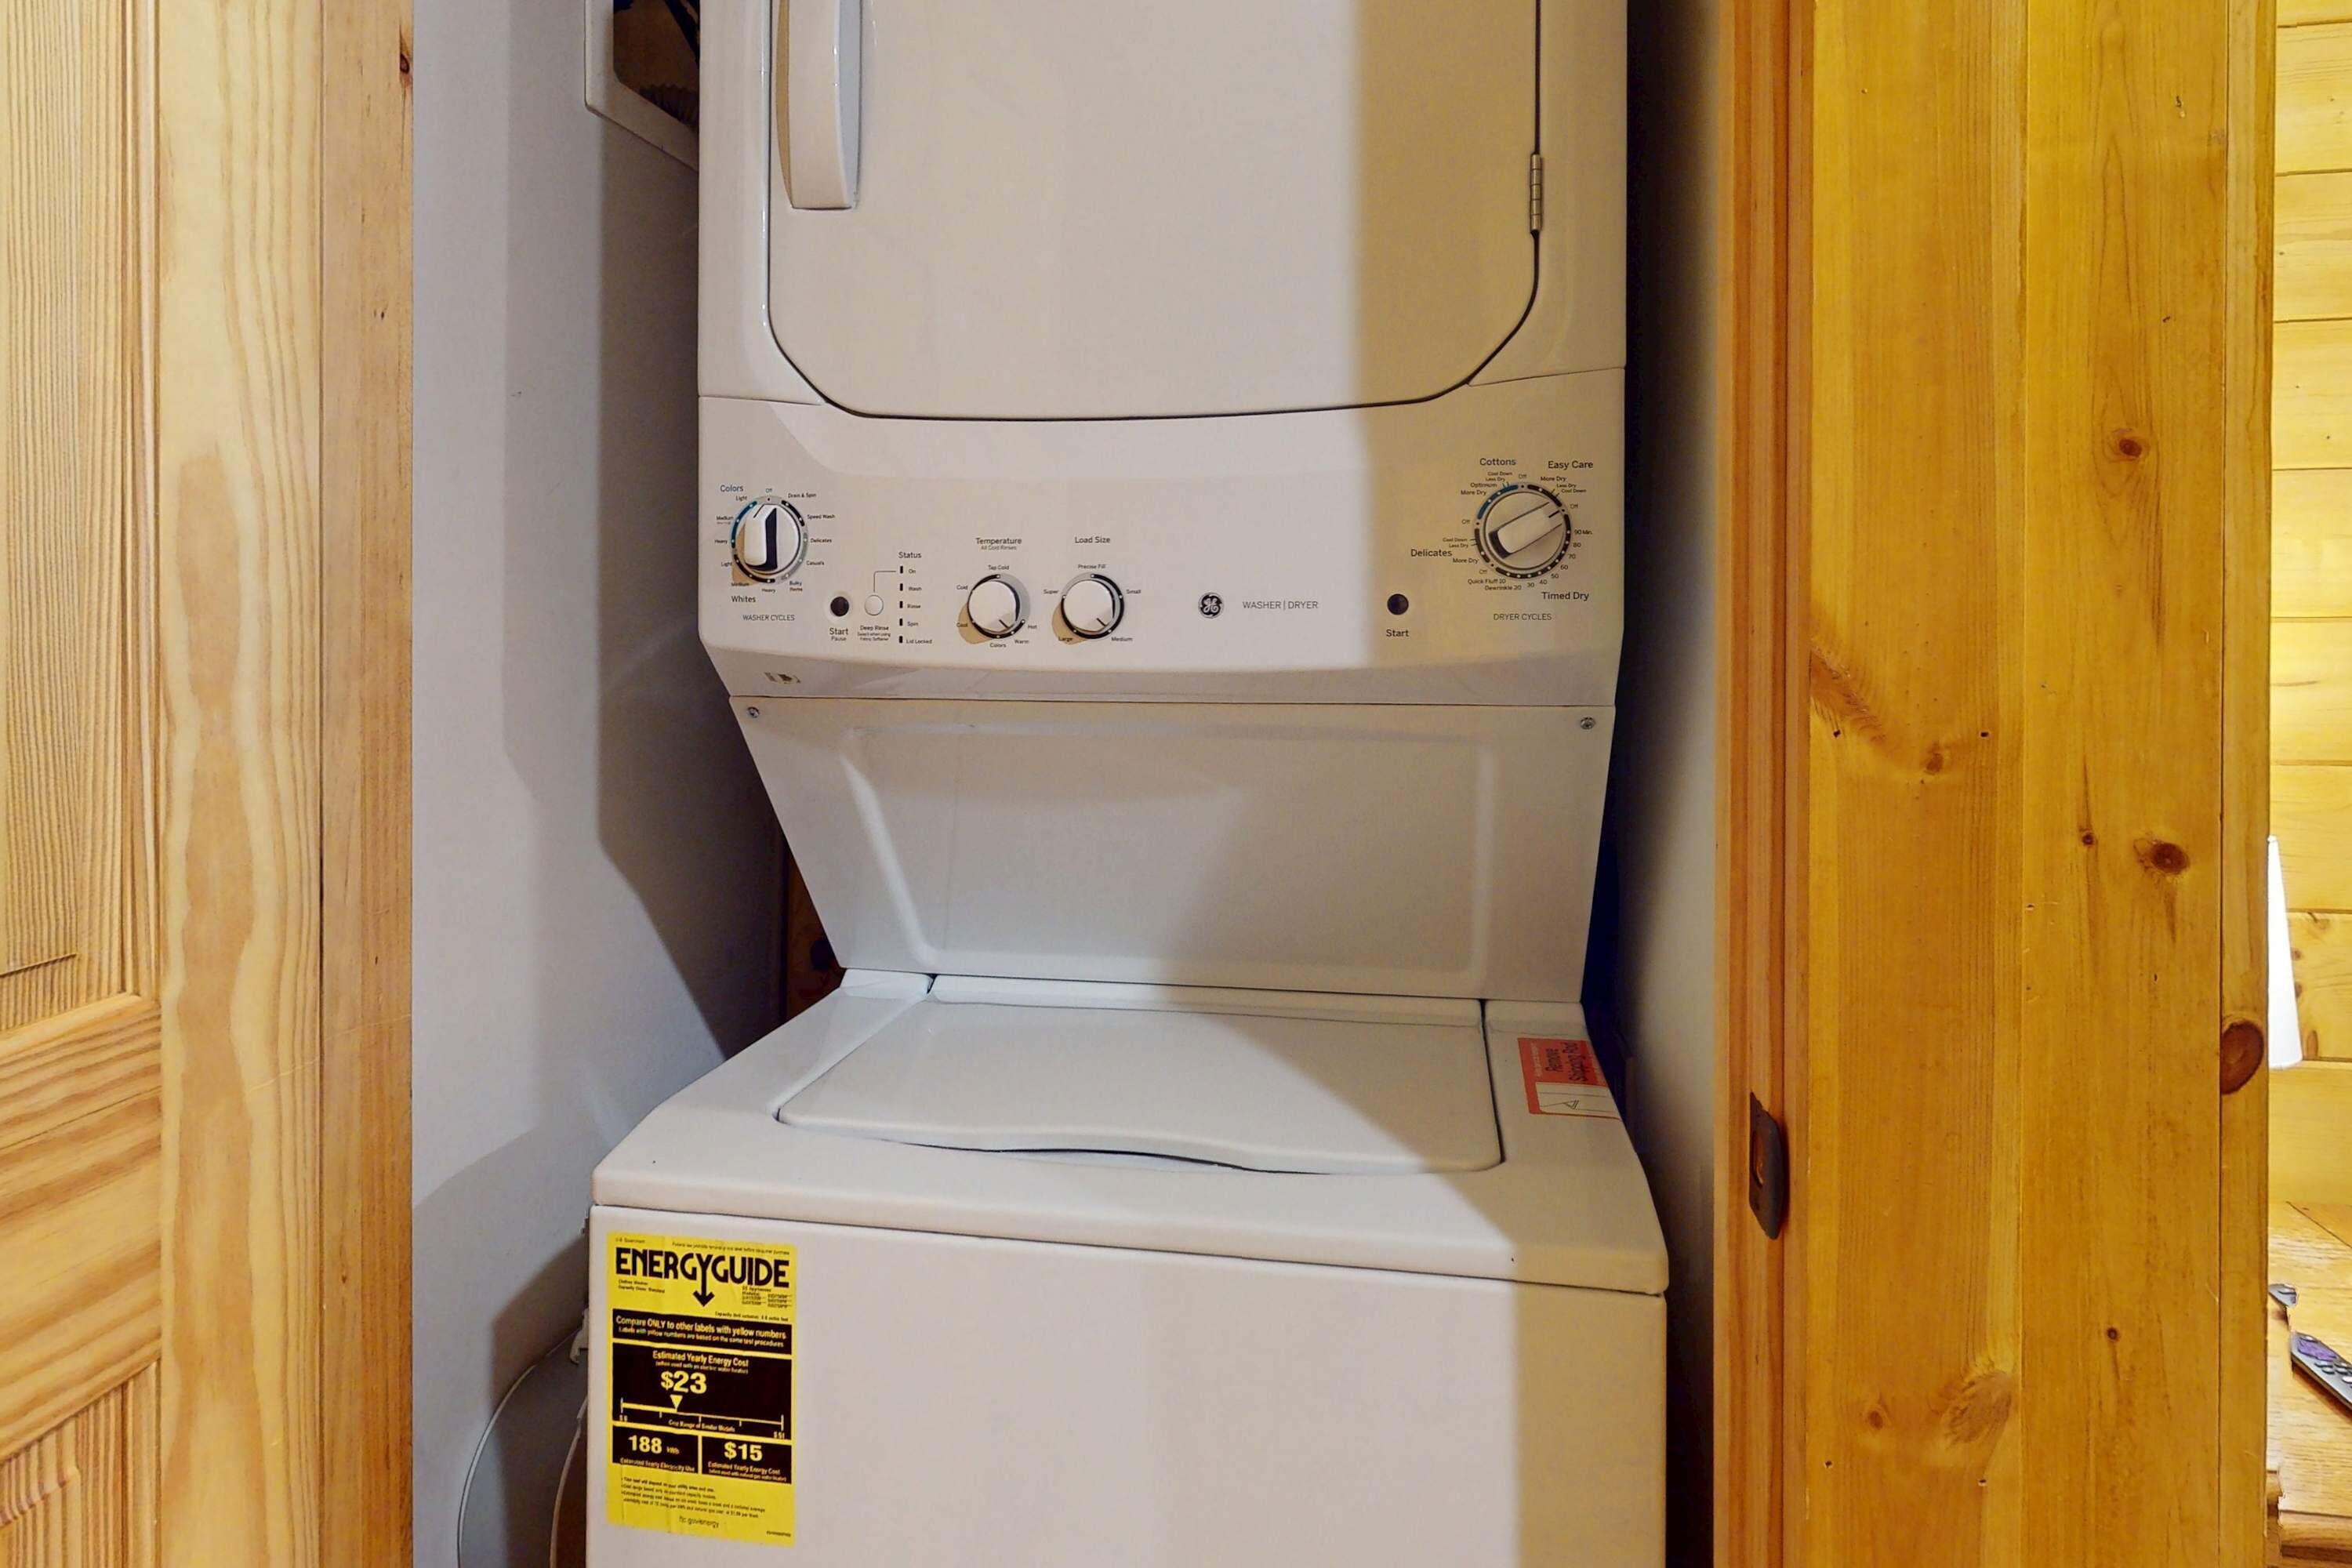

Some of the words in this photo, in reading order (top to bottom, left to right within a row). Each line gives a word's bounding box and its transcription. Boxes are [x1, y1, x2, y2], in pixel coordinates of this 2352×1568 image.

[1548, 461, 1570, 470] Easy
[975, 537, 1022, 546] Temperature
[1410, 549, 1453, 557] Delicates
[1541, 591, 1571, 601] Timed
[1572, 591, 1590, 602] Dry
[1242, 601, 1281, 609] WASHER
[1287, 601, 1319, 609] DRYER
[1385, 629, 1410, 637] Start
[615, 1247, 789, 1288] ENERGYGUIDE
[615, 1316, 646, 1327] Compare
[647, 1318, 666, 1329] ONLY
[666, 1320, 675, 1329] to
[676, 1322, 694, 1330] other
[694, 1322, 715, 1334] labels
[716, 1325, 731, 1334] with
[731, 1327, 754, 1338] yellow
[755, 1329, 787, 1340] numbers
[652, 1350, 686, 1361] Estimated
[687, 1352, 707, 1365] Yearly
[708, 1355, 732, 1367] Energy
[732, 1357, 749, 1367] Cost
[661, 1370, 707, 1395] $23
[628, 1435, 662, 1454] 188
[724, 1441, 764, 1462] $15
[708, 1461, 733, 1470] Estimated
[750, 1466, 768, 1475] Energy
